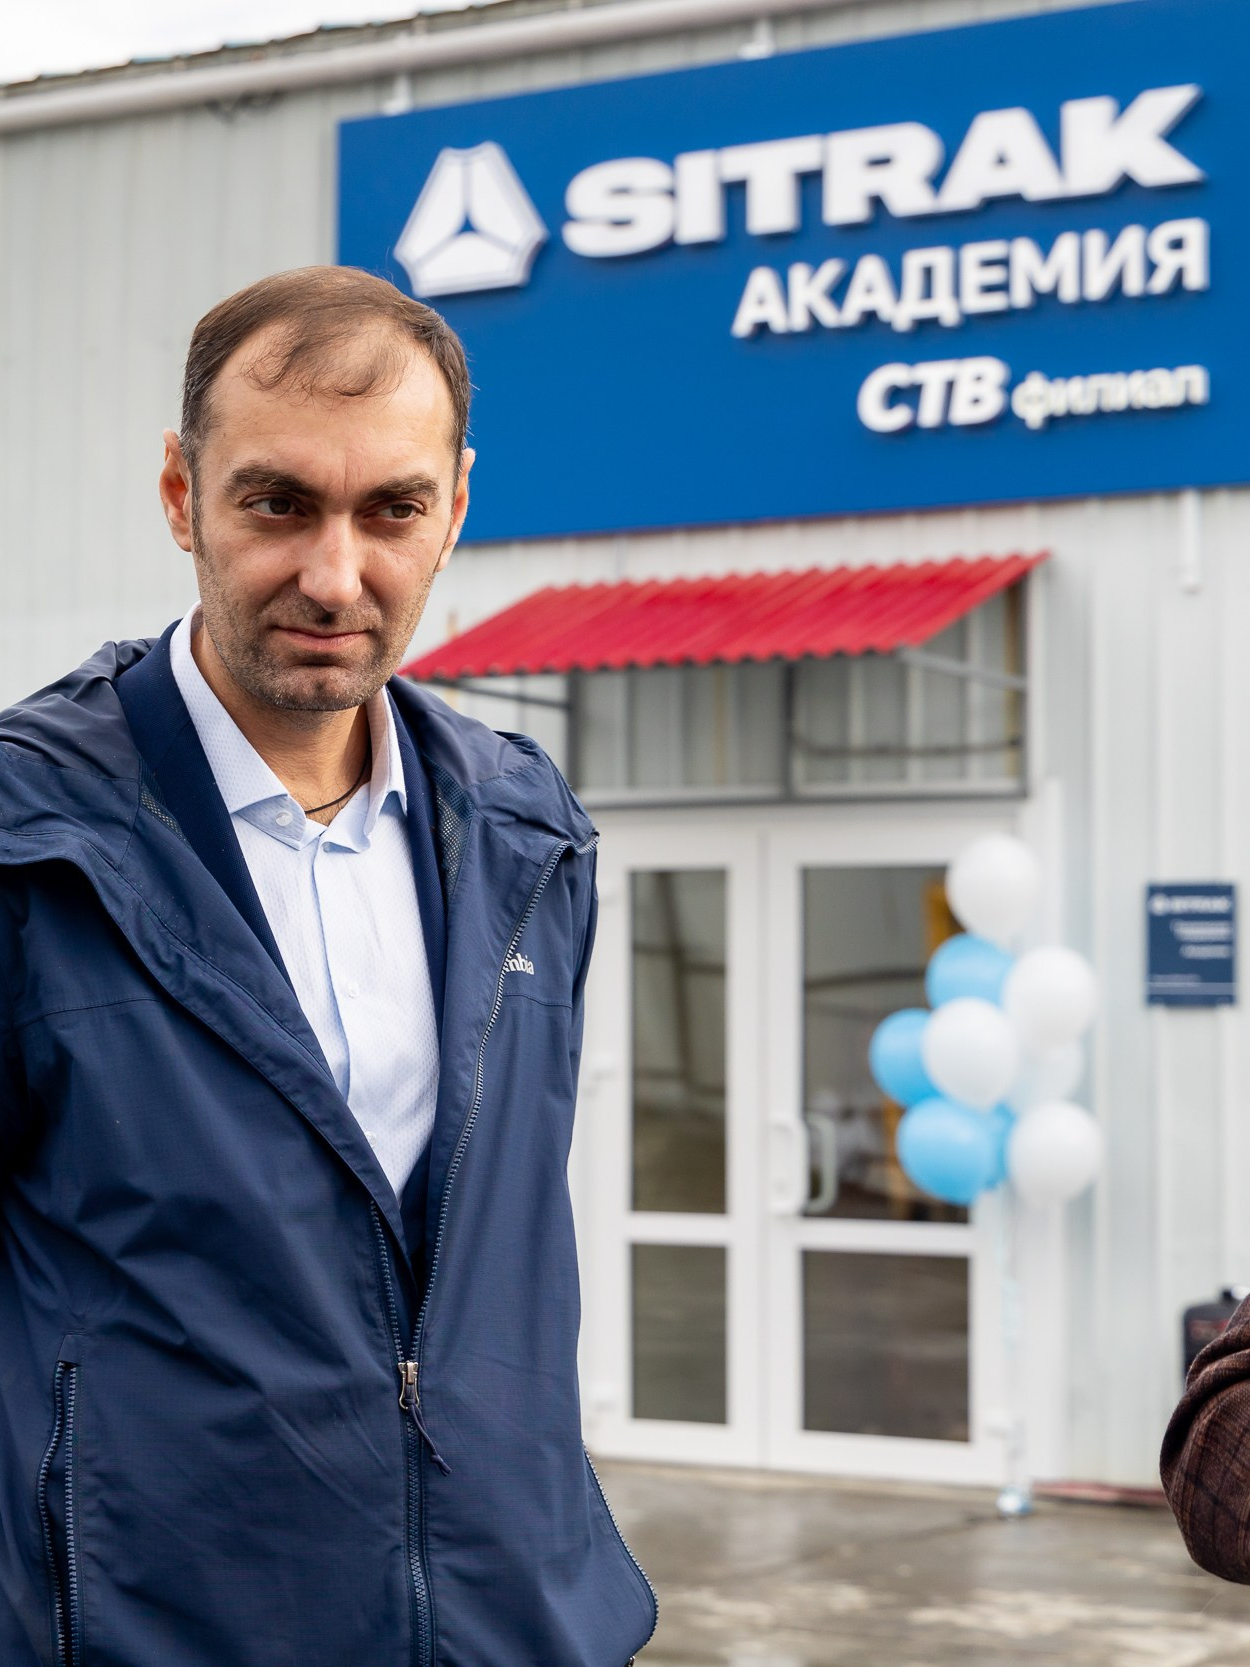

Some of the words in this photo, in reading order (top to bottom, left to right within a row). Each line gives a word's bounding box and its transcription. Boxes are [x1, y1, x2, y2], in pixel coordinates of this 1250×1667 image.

[564, 85, 1203, 257] SITRAK
[732, 218, 1209, 337] АКАДЕМИЯ
[1011, 365, 1209, 429] филиал
